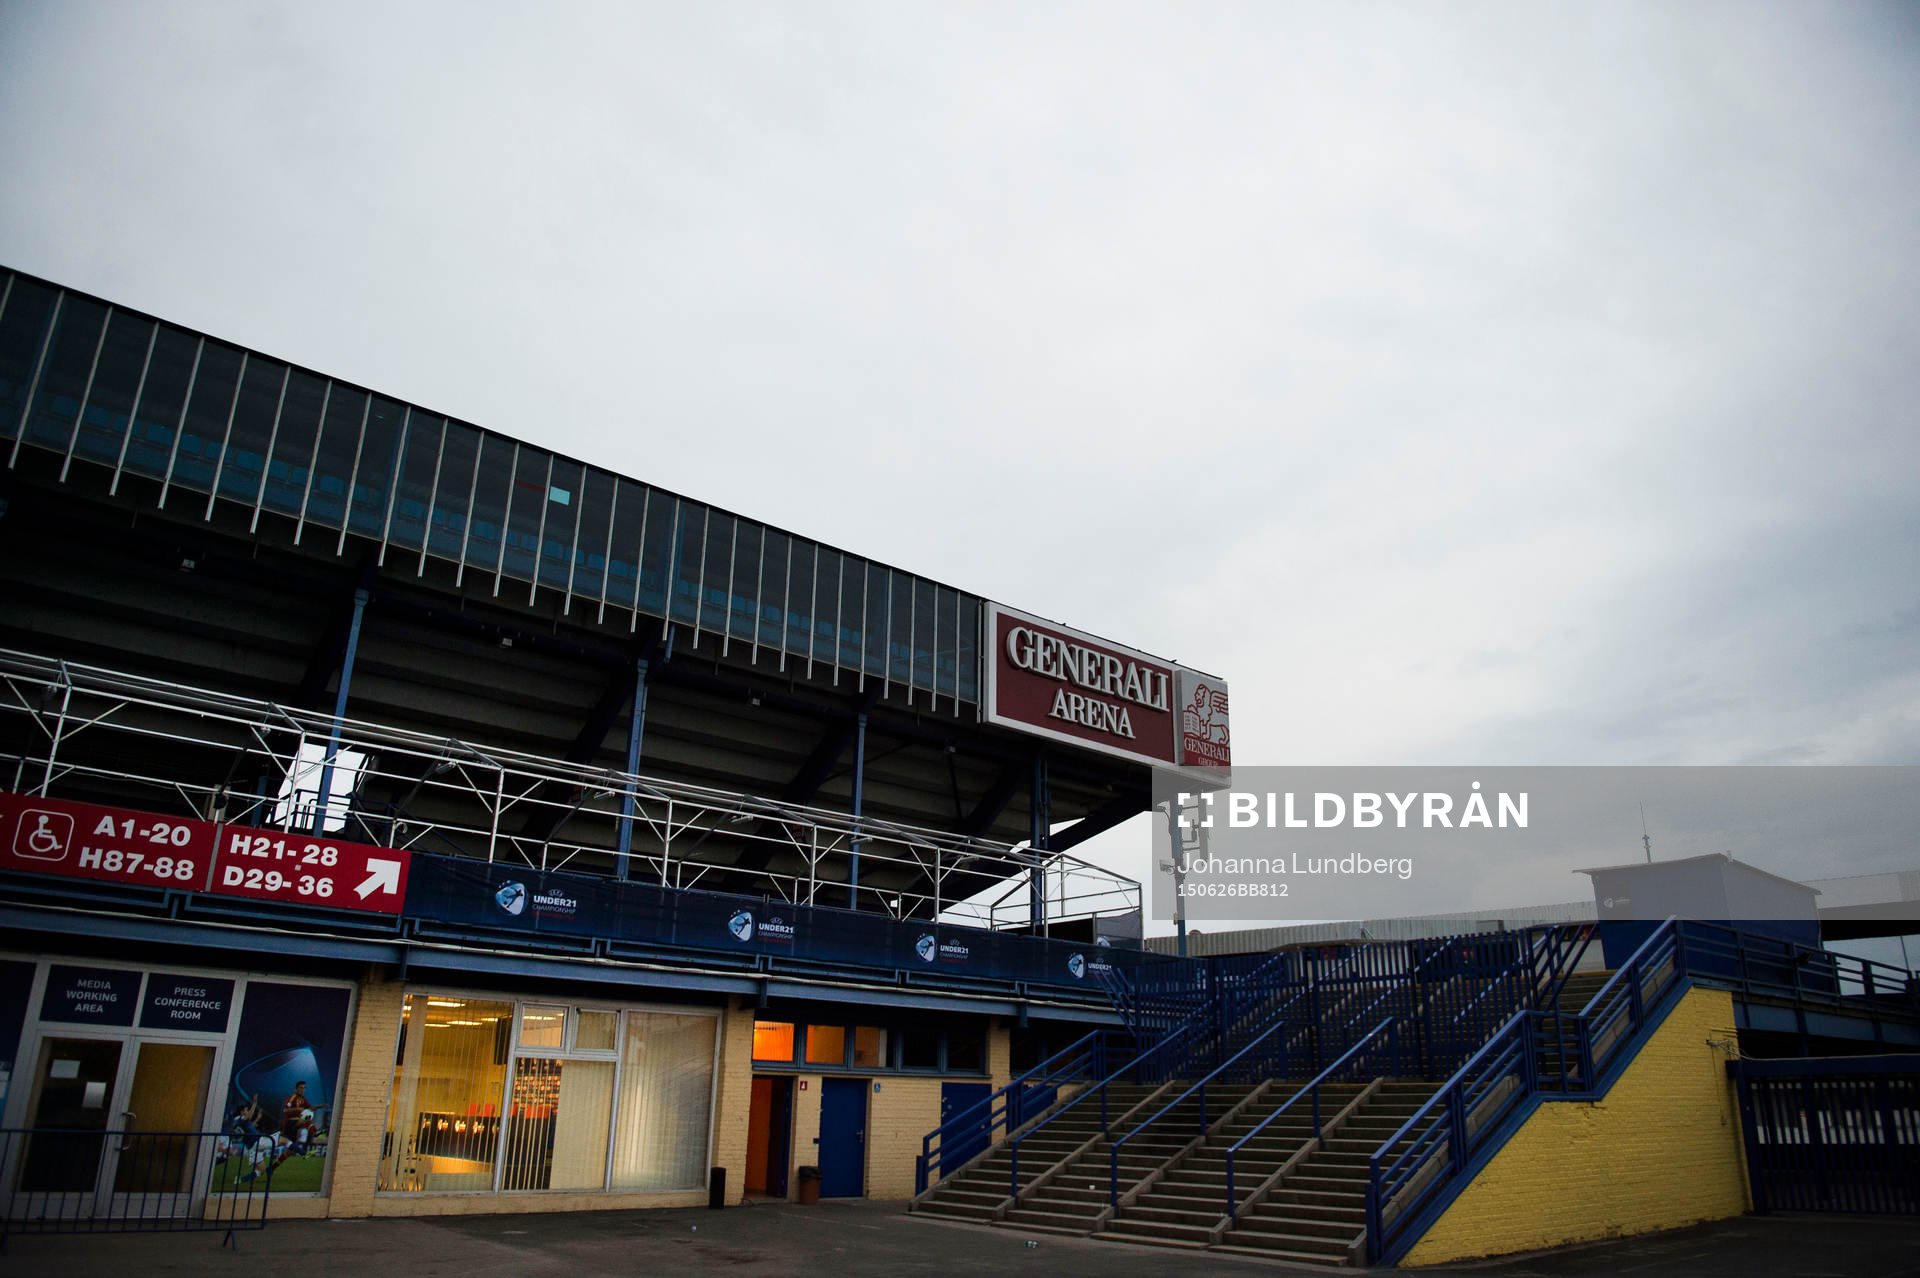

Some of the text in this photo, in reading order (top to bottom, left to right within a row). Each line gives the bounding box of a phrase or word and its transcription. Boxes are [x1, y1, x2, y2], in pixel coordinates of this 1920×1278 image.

[1007, 626, 1170, 712] GENERALI
[1048, 687, 1137, 740] ARENA
[1184, 737, 1230, 762] GENERALI
[93, 815, 192, 847] A1-20
[78, 846, 195, 881] H87-88
[533, 895, 578, 908] UNDER21
[76, 979, 112, 990] MEDIA
[66, 990, 118, 1003] WORKING
[174, 986, 206, 998] PRESS
[74, 1003, 104, 1013] AREA
[154, 997, 222, 1010] CONFERENCE
[170, 1009, 201, 1020] ROOM
